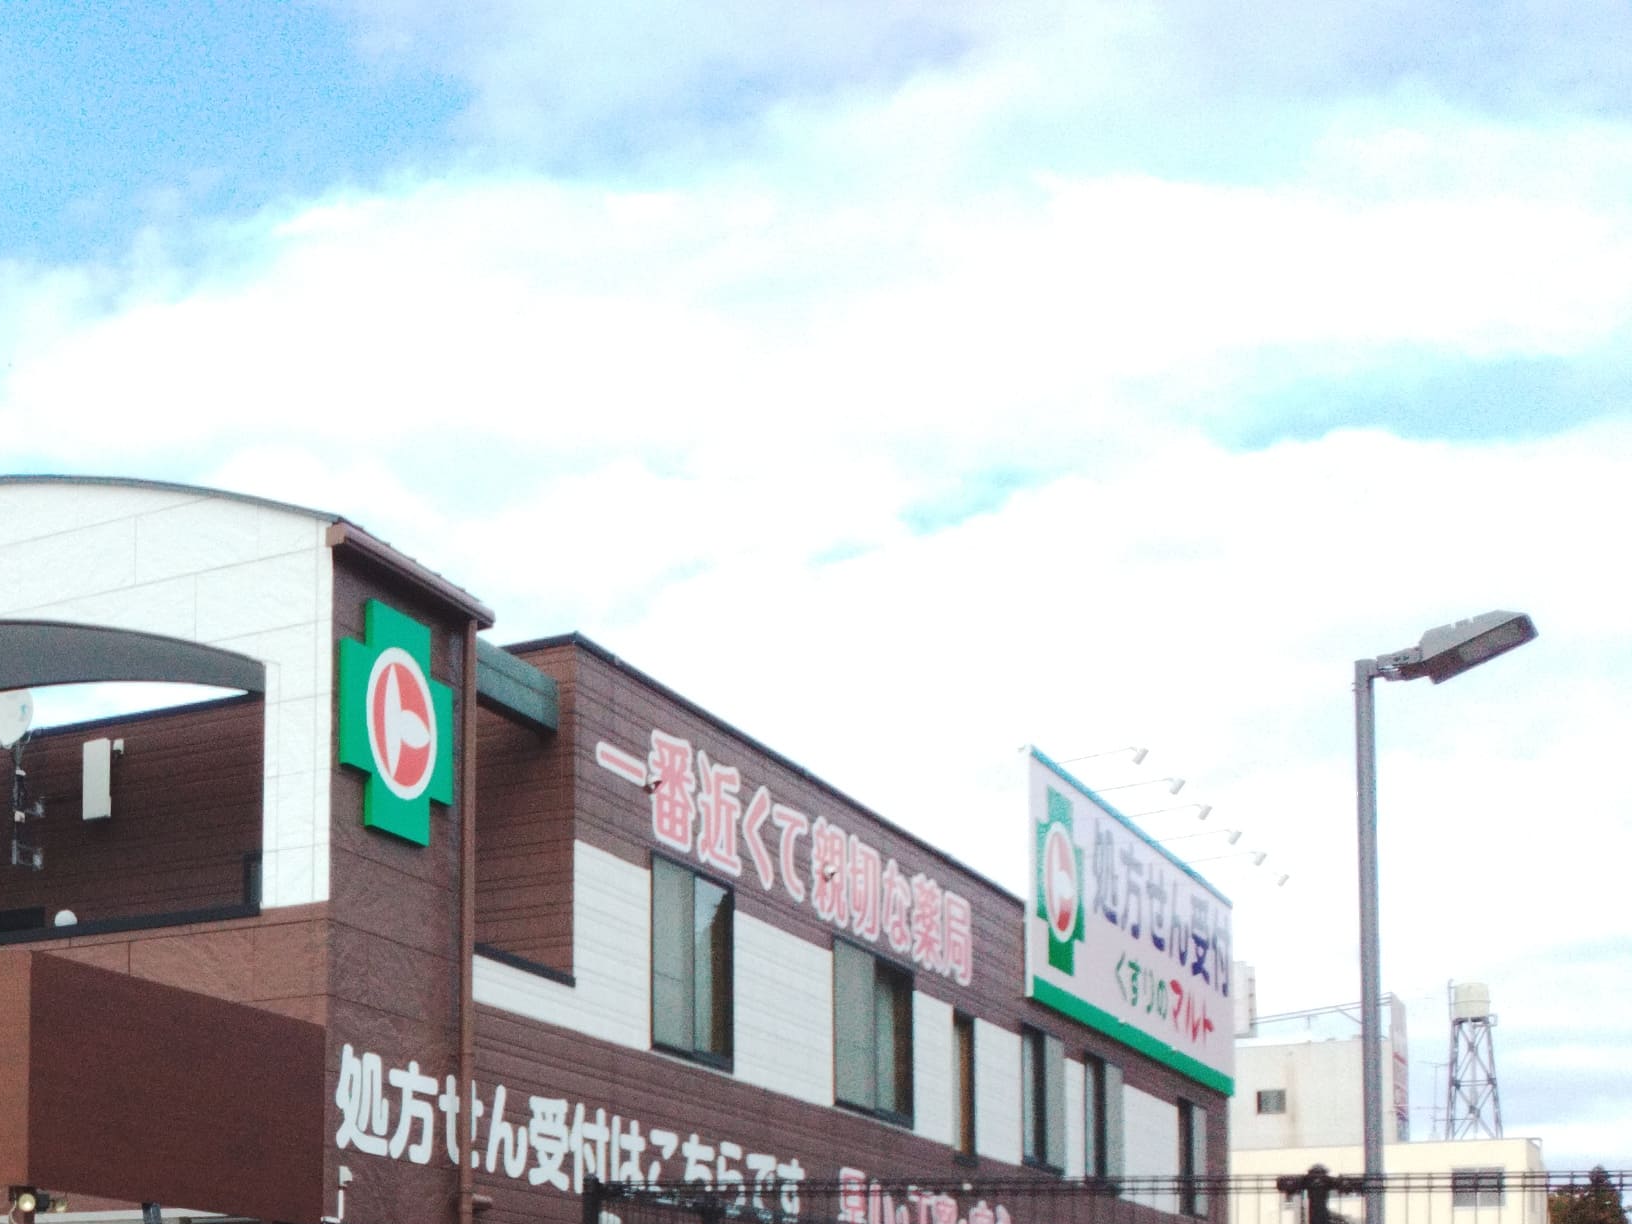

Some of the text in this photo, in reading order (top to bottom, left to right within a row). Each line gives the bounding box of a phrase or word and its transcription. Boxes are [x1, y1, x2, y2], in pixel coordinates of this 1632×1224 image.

[596, 729, 972, 987] 一番近くて親切な薬局
